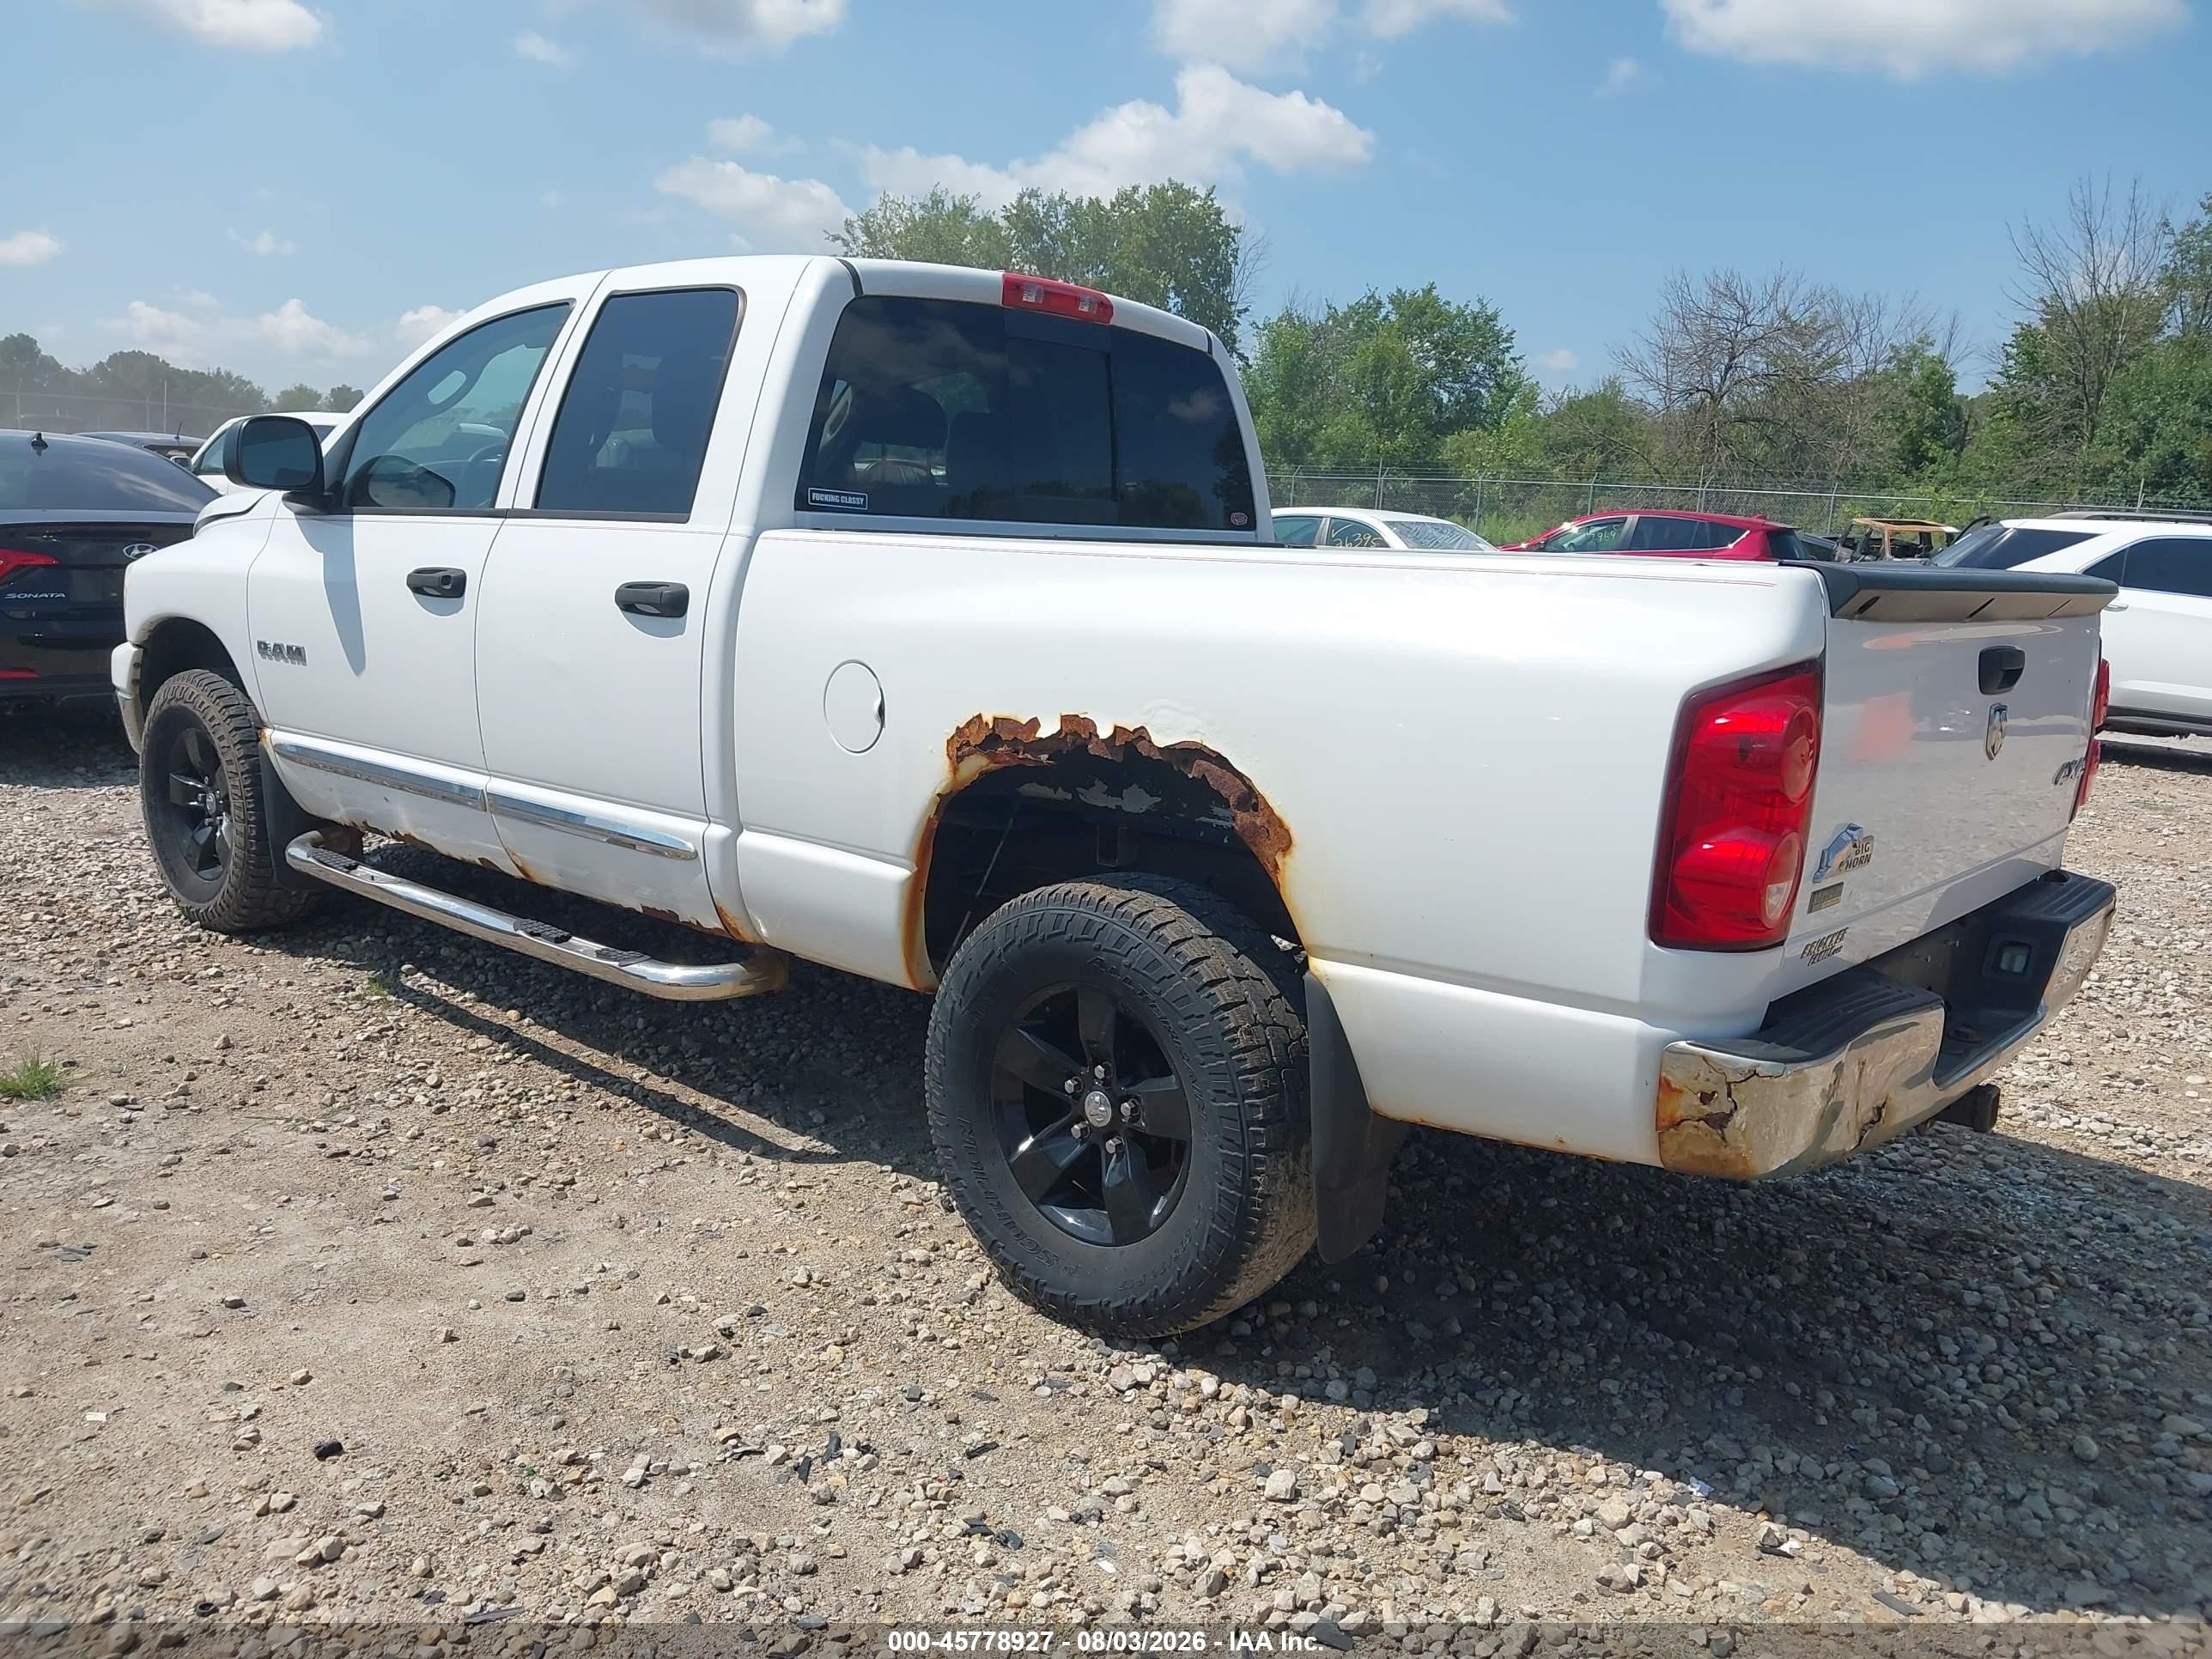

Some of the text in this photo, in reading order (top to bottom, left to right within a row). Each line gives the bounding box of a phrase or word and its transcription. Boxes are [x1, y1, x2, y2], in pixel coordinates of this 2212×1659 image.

[811, 492, 865, 506] FUCKING CLASSY
[257, 640, 307, 667] RAM
[1855, 842, 1870, 856] BIG
[1844, 853, 1872, 871] HORN
